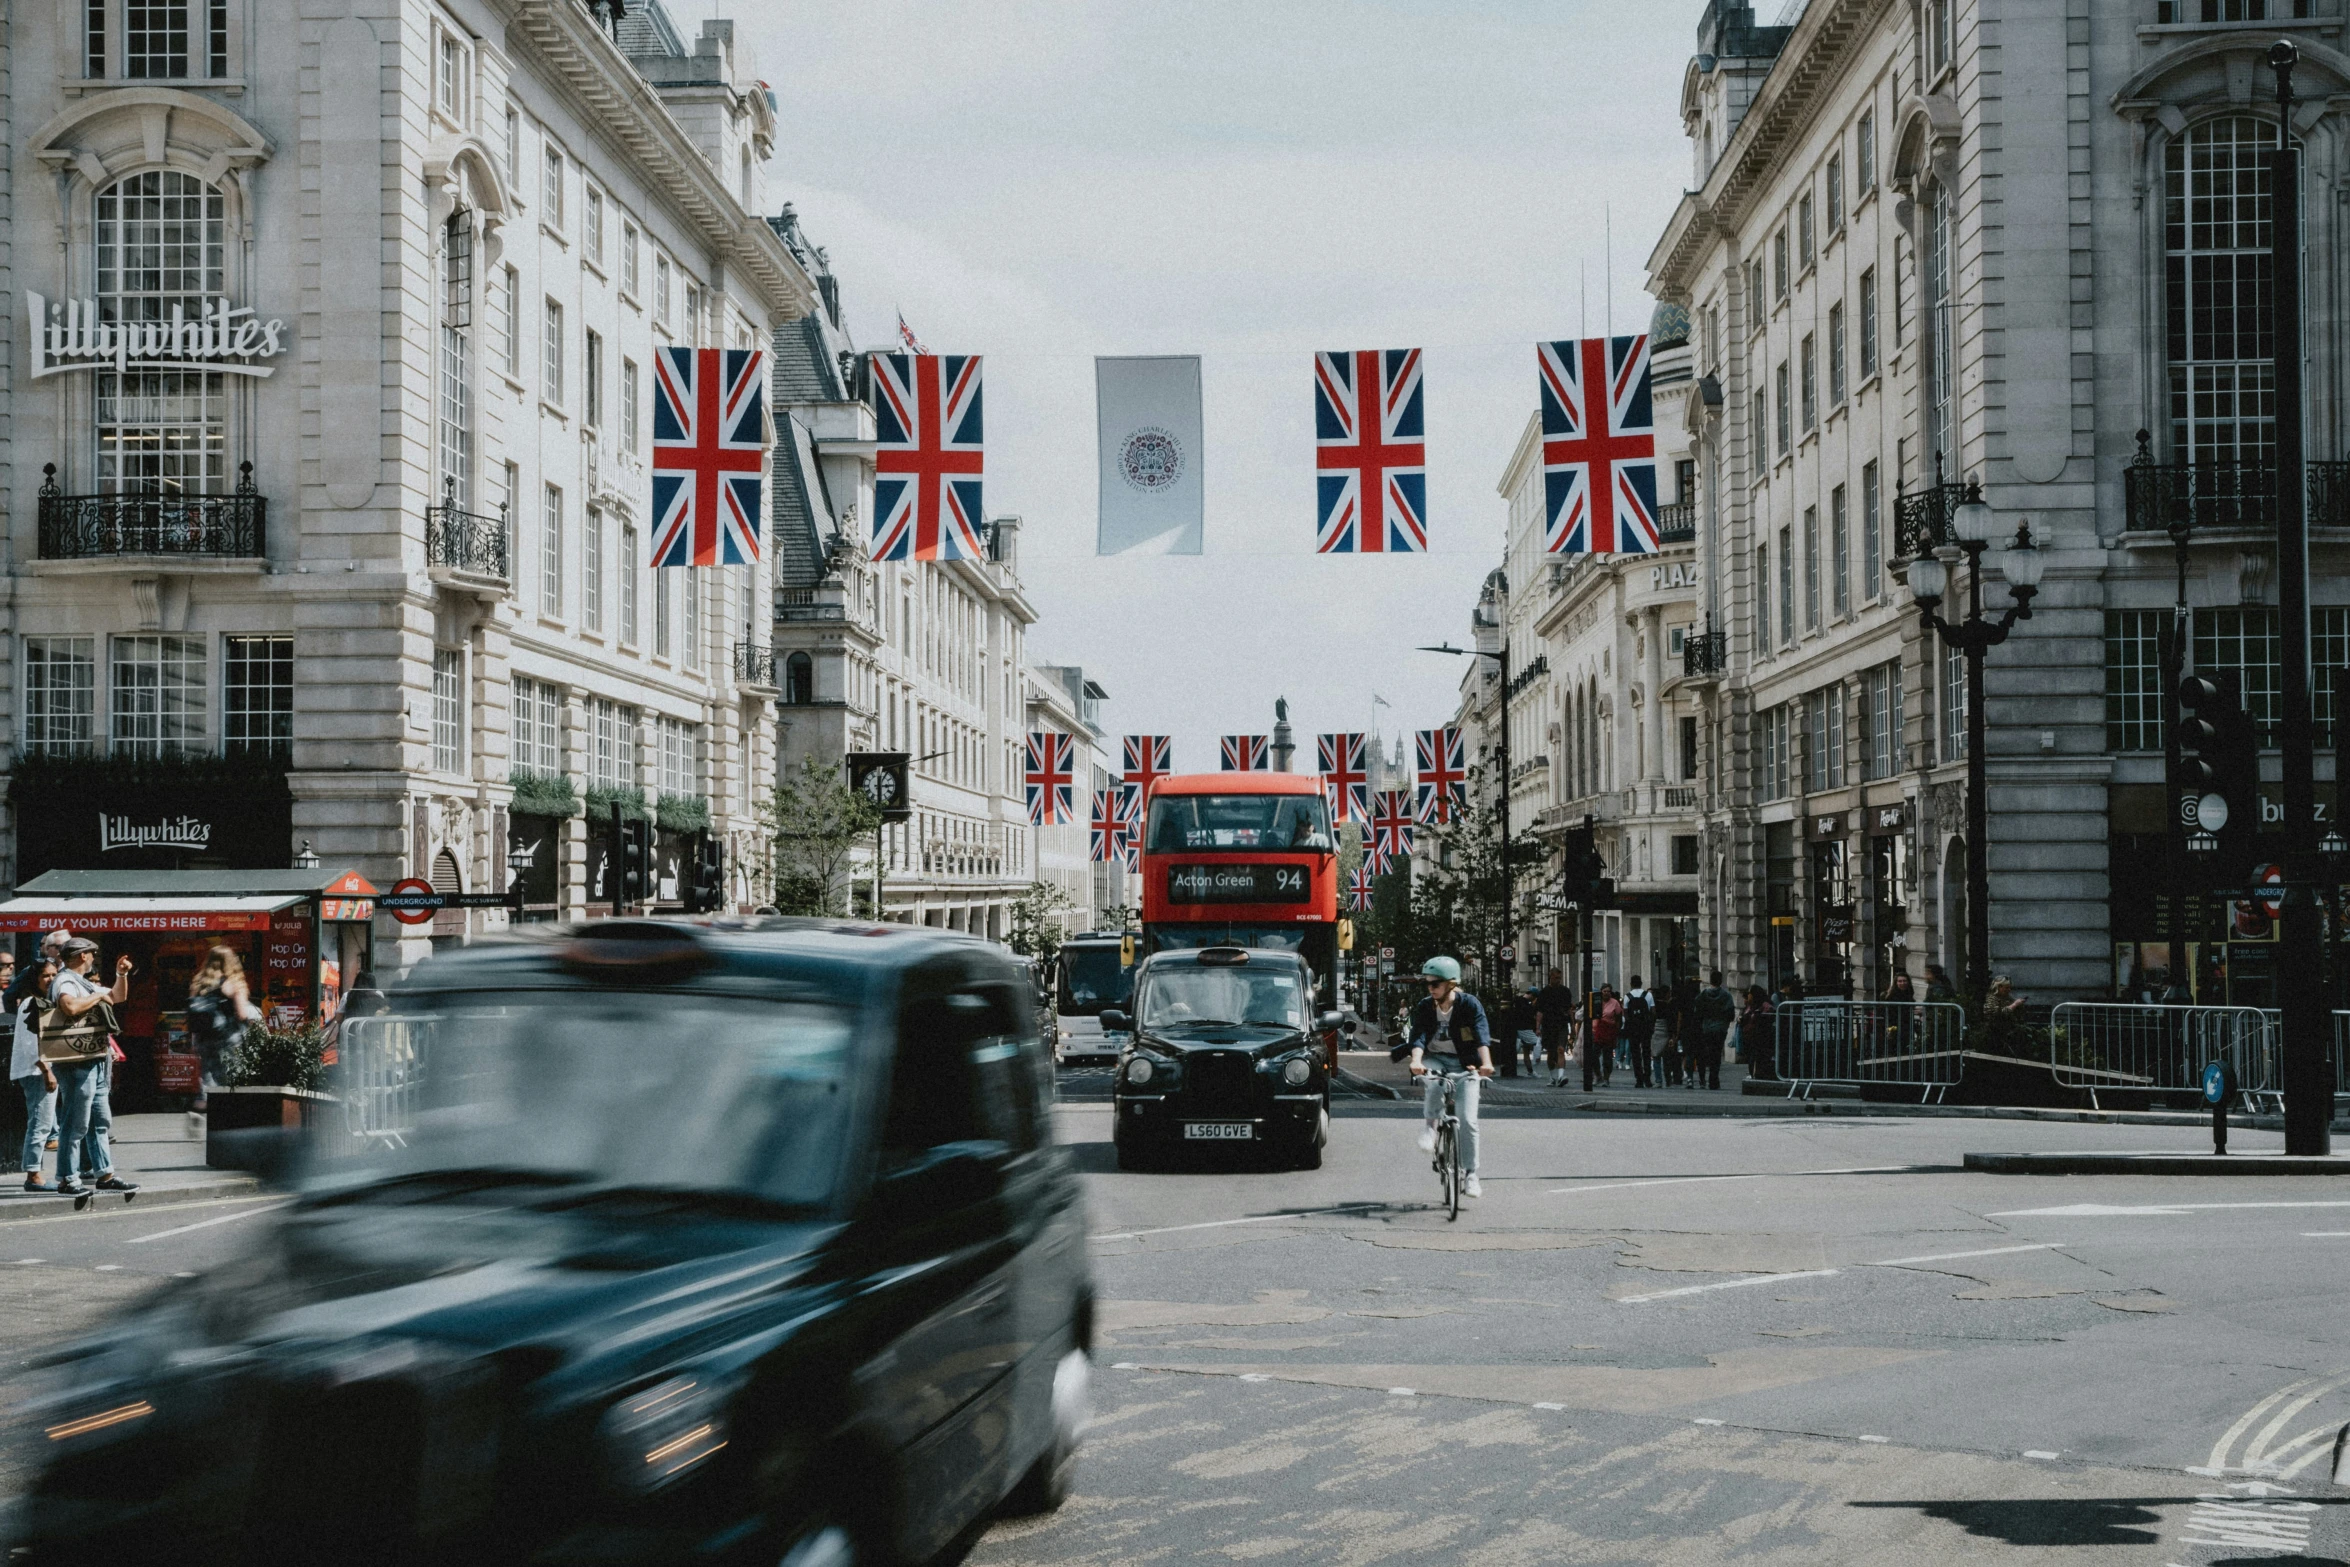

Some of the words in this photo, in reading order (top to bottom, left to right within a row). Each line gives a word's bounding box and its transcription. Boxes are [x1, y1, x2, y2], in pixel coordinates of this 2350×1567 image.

[25, 290, 285, 378] Lillywhites
[1121, 431, 1138, 447] KING
[1138, 426, 1173, 438] CHARLES
[1172, 436, 1181, 446] III
[1117, 452, 1147, 494] CORONATION
[1170, 472, 1182, 486] MAY
[1650, 563, 1696, 591] PLAZ
[2261, 796, 2326, 822] bz
[99, 812, 212, 851] Lillywhites
[1175, 872, 1212, 886] Acton
[1215, 872, 1253, 886] Green
[1276, 869, 1303, 890] 94
[2254, 888, 2286, 896] UNDERGRO
[382, 897, 443, 905] UNDERGROUND
[1536, 893, 1578, 911] CINEMA
[39, 918, 67, 929] BUY
[70, 918, 109, 928] YOUR
[112, 917, 167, 928] TICKETS
[171, 917, 206, 927] HERE
[1824, 917, 1849, 928] Pizza
[281, 929, 299, 937] TRAVEL
[1827, 927, 1844, 936] Hut
[271, 944, 290, 955] Hop
[292, 943, 306, 954] On
[1502, 949, 1513, 957] 20
[269, 958, 289, 969] Hop
[291, 957, 307, 968] Off
[1189, 1125, 1221, 1137] LS60
[1224, 1125, 1248, 1137] GVE
